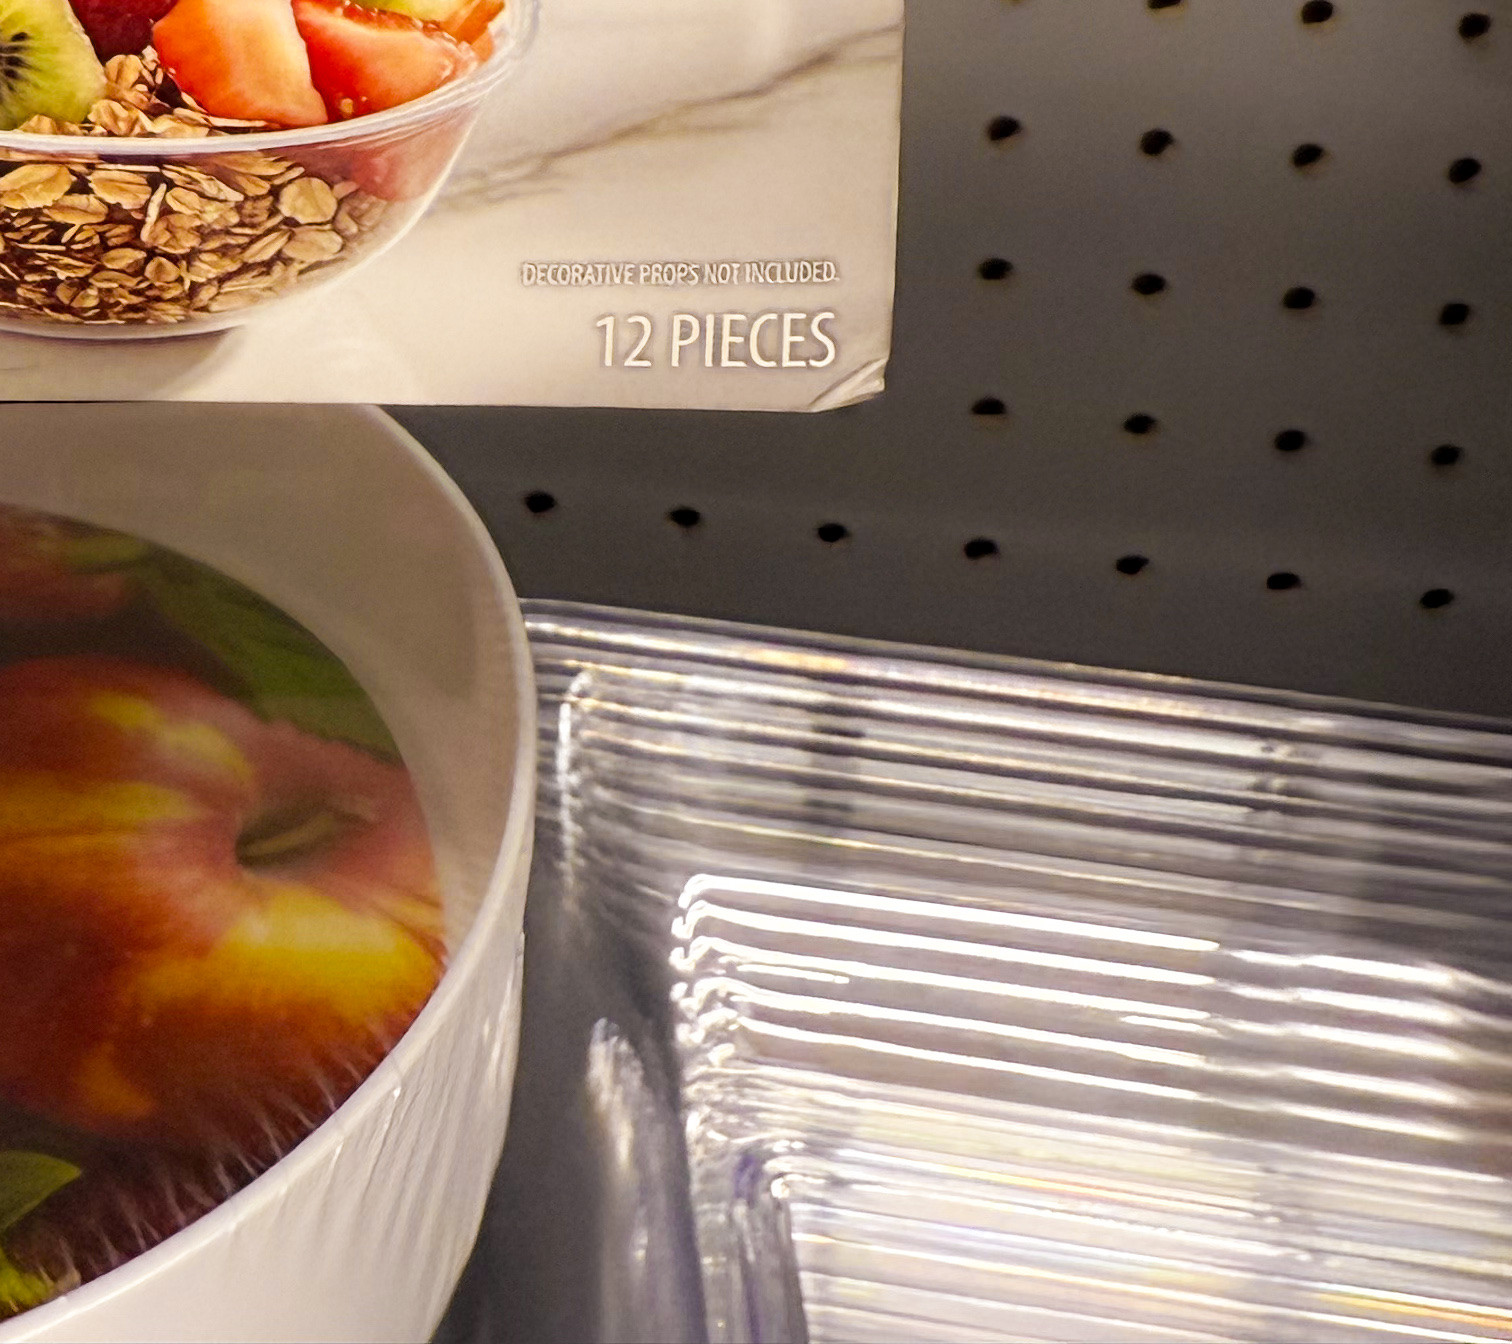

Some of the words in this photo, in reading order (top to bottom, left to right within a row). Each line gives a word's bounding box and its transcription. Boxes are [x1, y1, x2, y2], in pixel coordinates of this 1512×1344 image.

[522, 261, 635, 286] DECORATIVE
[639, 262, 699, 286] PROPS
[704, 262, 741, 285] NOT
[595, 314, 652, 368] 12
[670, 311, 836, 368] PIECES
